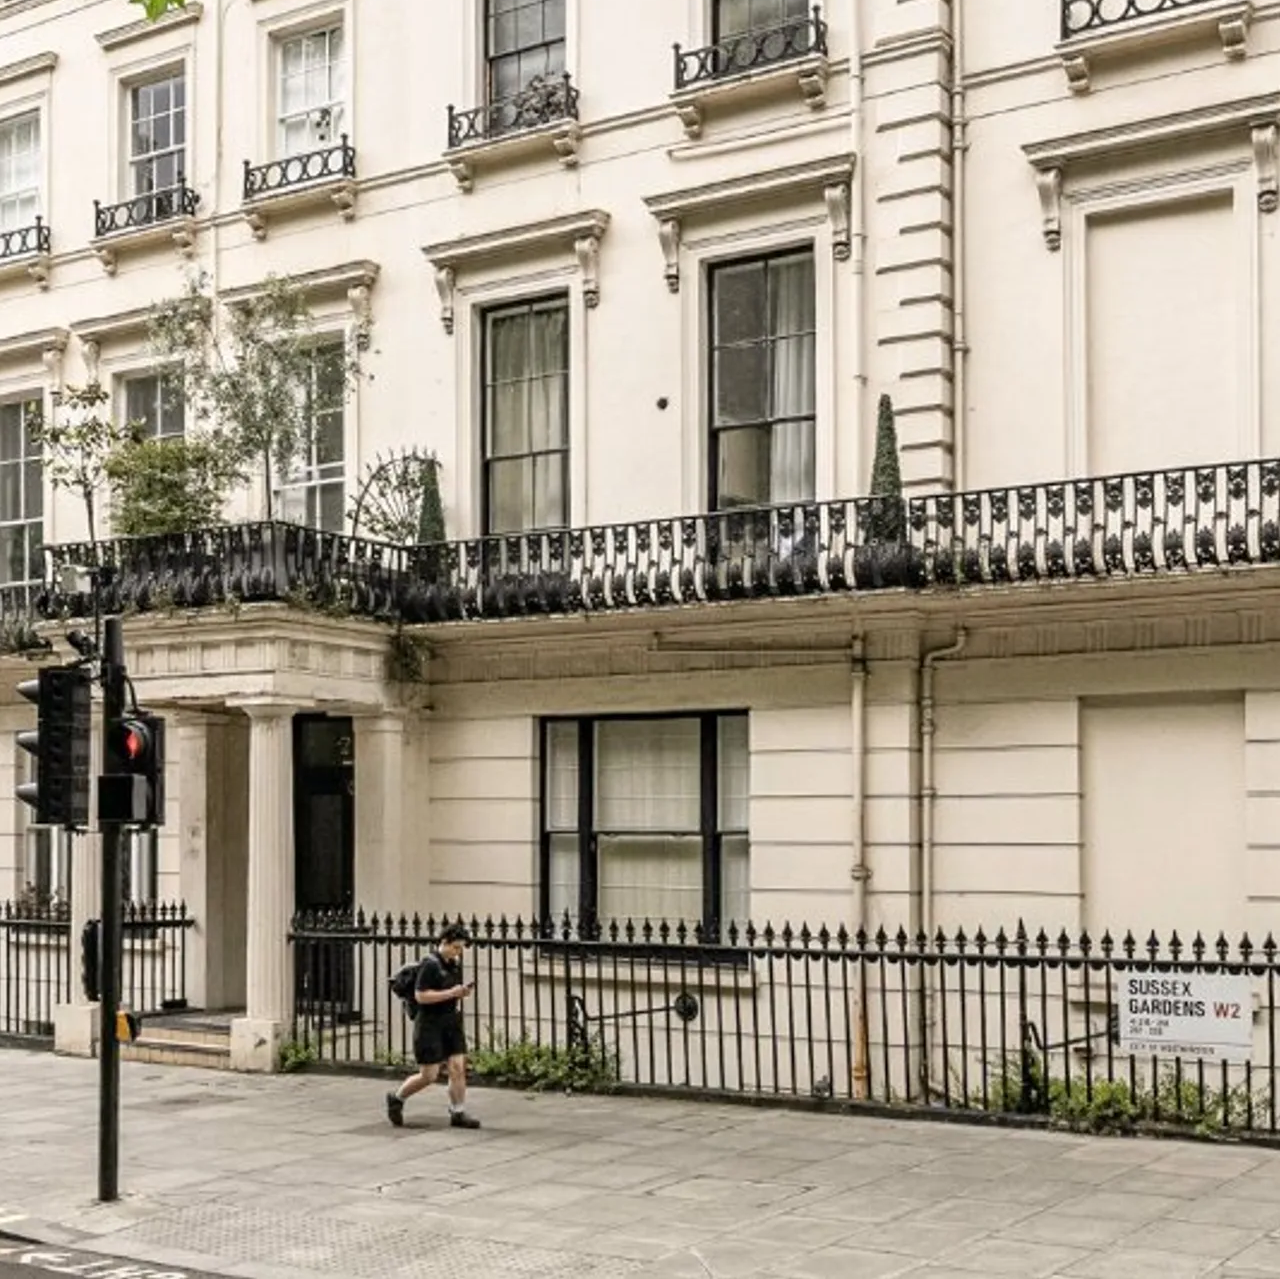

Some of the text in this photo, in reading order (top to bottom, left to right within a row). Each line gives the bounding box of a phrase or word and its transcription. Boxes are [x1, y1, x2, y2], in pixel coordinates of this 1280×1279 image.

[1128, 979, 1193, 997] SUSSEX
[1128, 998, 1242, 1019] GARDENS W2
